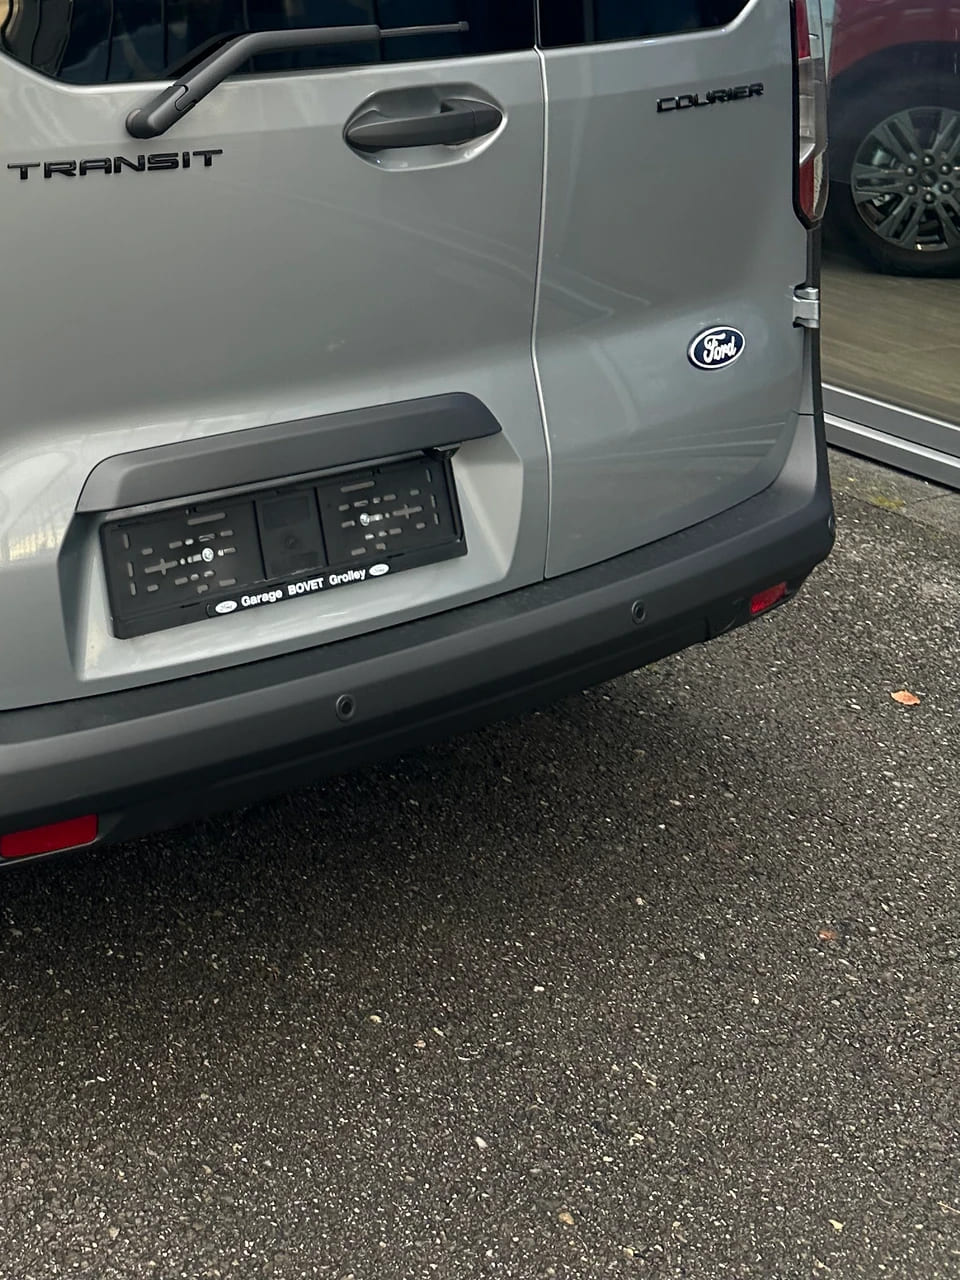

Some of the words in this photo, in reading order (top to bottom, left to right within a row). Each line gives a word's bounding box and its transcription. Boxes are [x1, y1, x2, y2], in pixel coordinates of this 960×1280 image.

[656, 82, 764, 113] COURIER
[7, 149, 223, 180] TRANSIT
[241, 589, 283, 607] Garage
[288, 578, 324, 595] BOVET
[329, 569, 366, 586] Grolley
